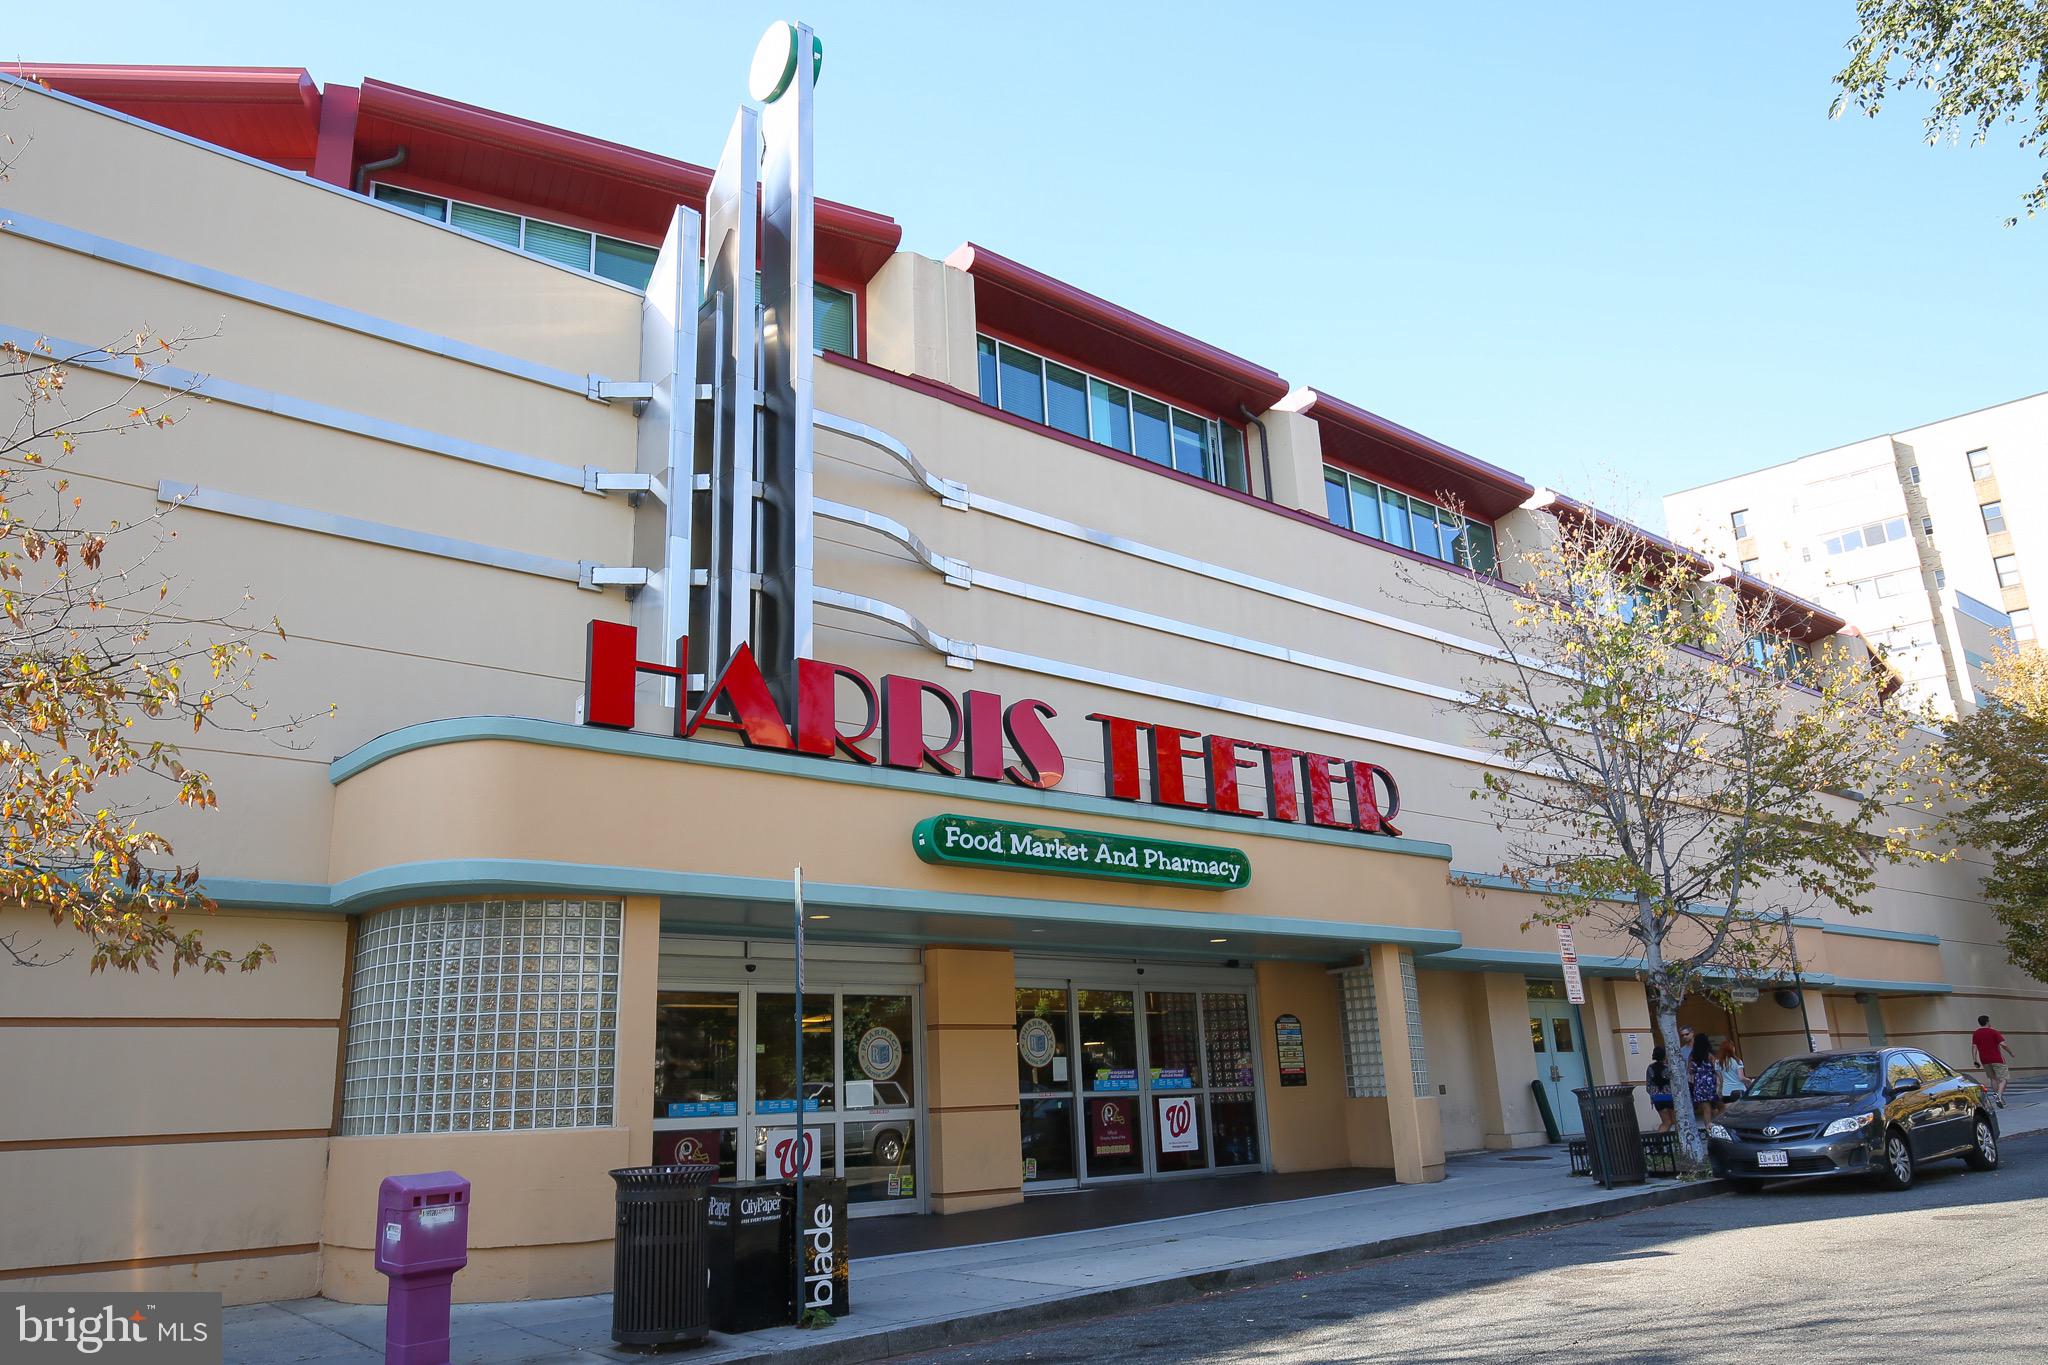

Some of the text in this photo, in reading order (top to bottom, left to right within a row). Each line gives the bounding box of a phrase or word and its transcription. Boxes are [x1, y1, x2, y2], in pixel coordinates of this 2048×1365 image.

[585, 620, 1403, 836] HARRIS TEETER
[945, 827, 1241, 882] Food Market And Pharmacy
[861, 1029, 900, 1051] PHARMACY
[1021, 1020, 1054, 1041] PHARMACY
[1166, 1099, 1191, 1138] W
[774, 1132, 813, 1179] W
[741, 1197, 781, 1216] CityPaper
[804, 1203, 833, 1308] blade
